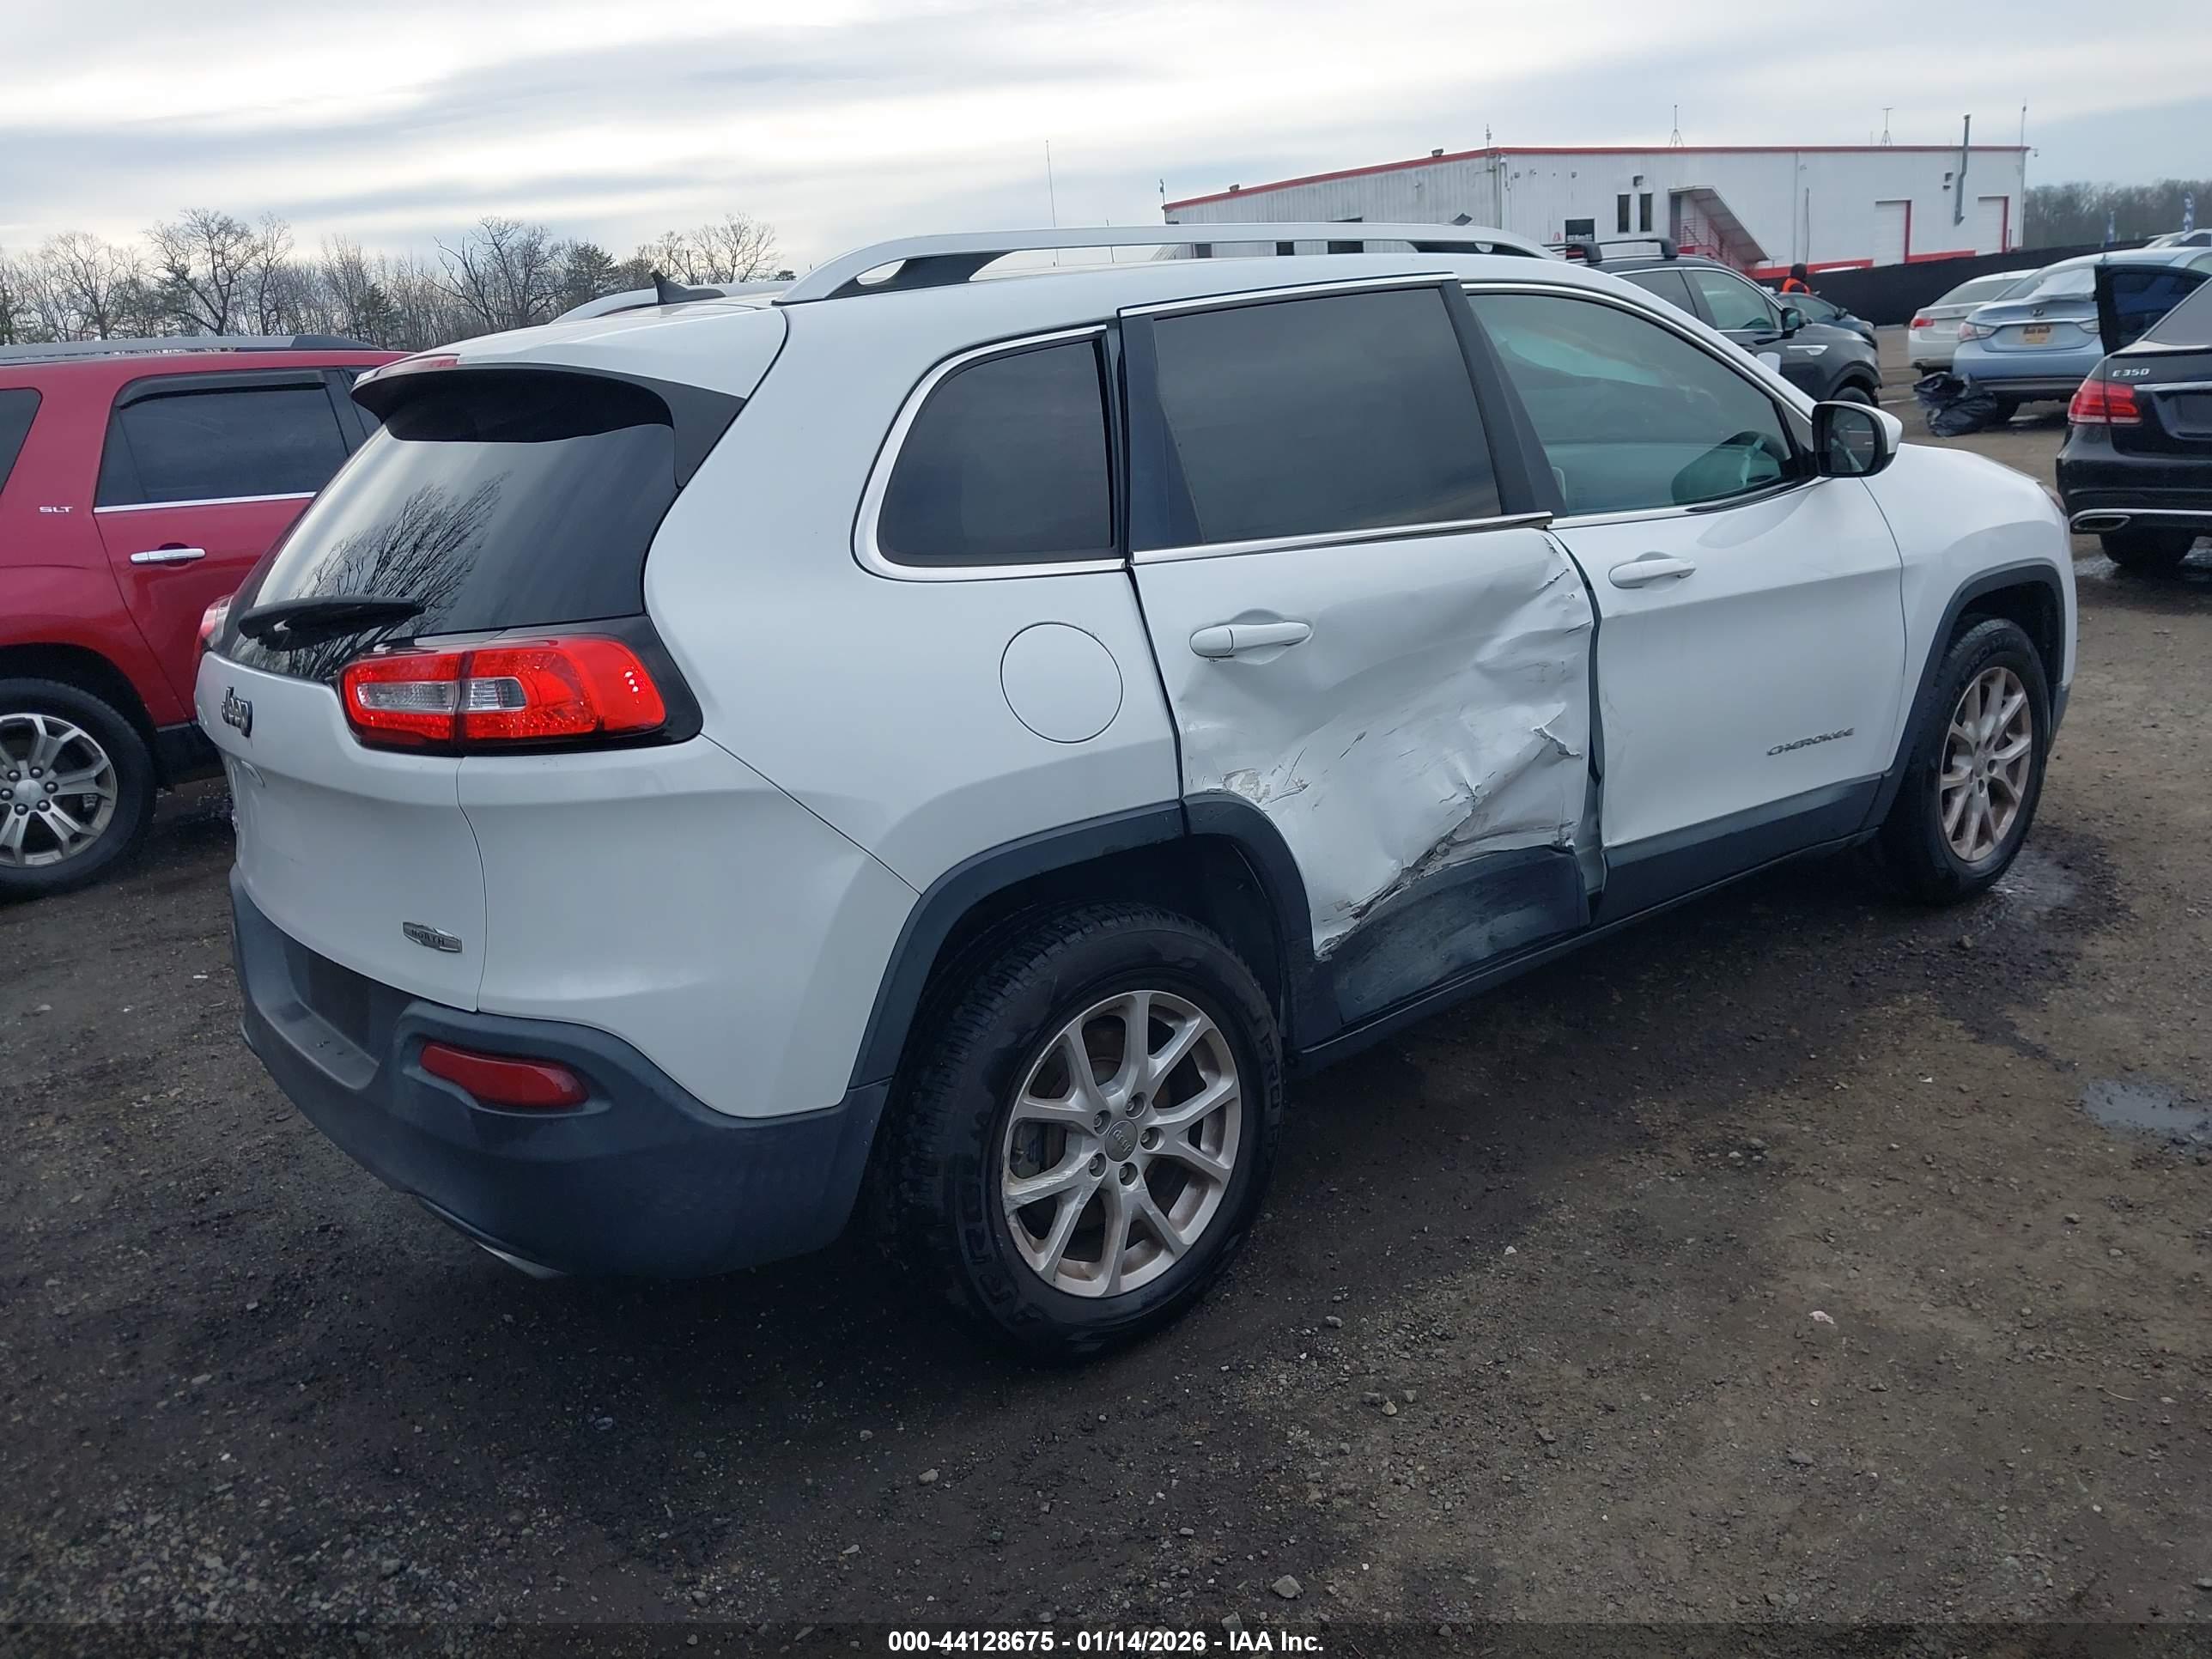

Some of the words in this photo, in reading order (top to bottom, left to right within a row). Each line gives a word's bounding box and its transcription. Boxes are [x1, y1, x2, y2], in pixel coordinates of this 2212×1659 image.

[2112, 369, 2121, 378] E
[2122, 368, 2150, 377] 350
[221, 686, 253, 738] Jeep
[1766, 727, 1855, 756] CHEROKEE
